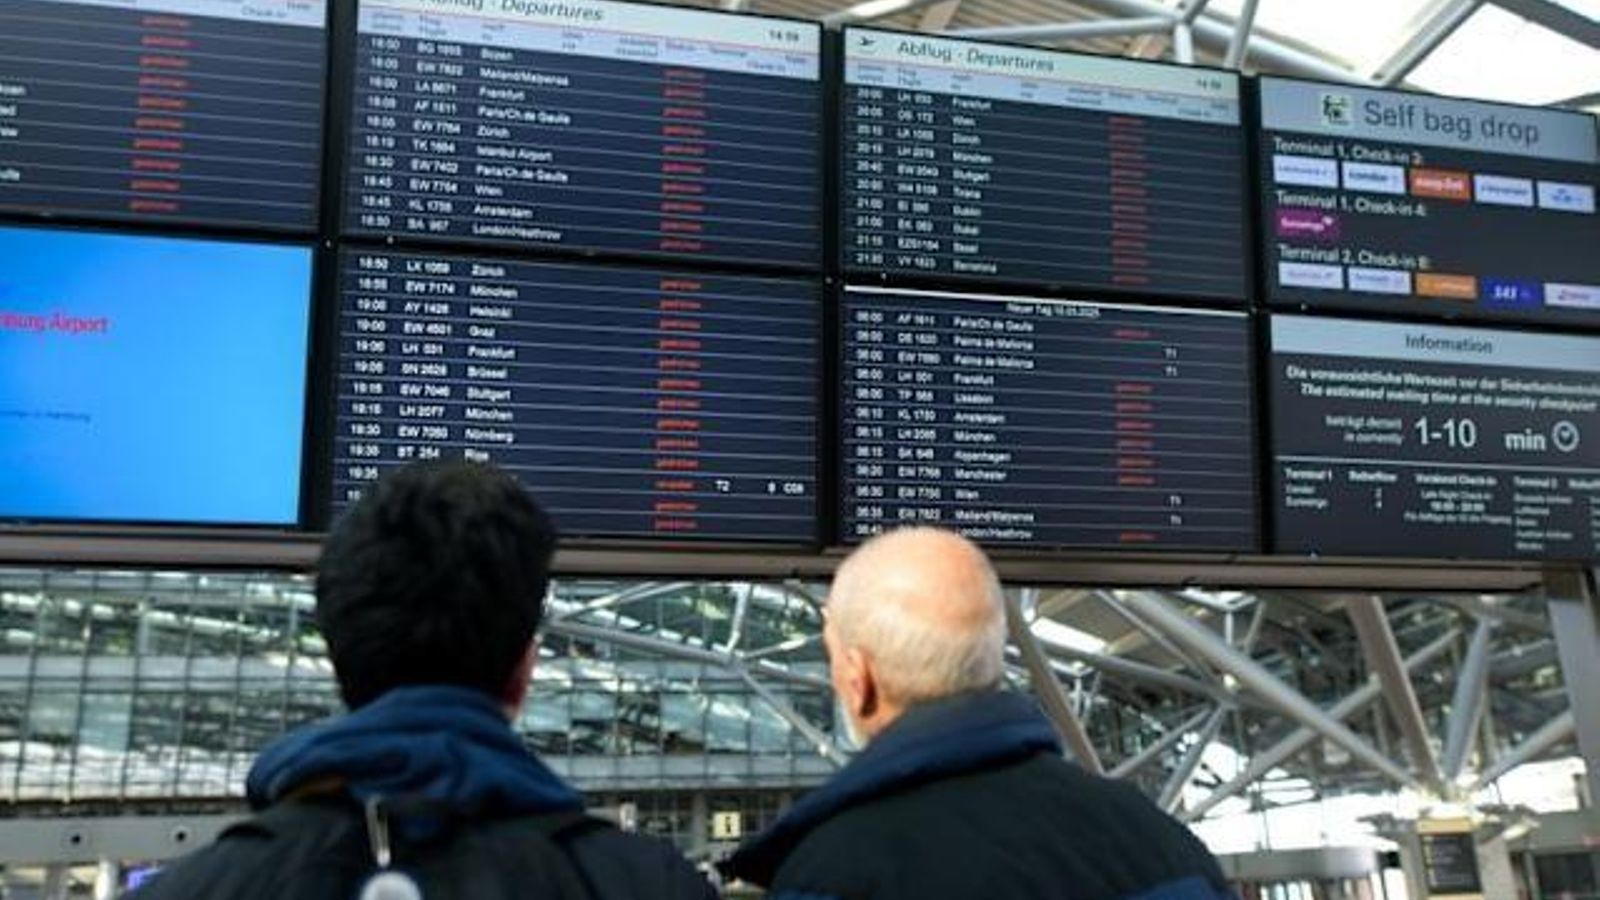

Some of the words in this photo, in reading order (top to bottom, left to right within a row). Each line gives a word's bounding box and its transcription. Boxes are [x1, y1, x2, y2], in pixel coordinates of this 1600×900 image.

[501, 0, 604, 21] Departures
[898, 41, 951, 62] Abflug
[967, 49, 1054, 70] Departures
[1364, 100, 1417, 126] Self
[1424, 108, 1472, 140] bag
[1481, 114, 1540, 146] drop
[1274, 137, 1335, 156] Terminal
[1354, 145, 1407, 162] Check-in
[1276, 191, 1337, 209] Terminal
[1356, 197, 1412, 215] Check-in
[1278, 244, 1339, 261] Terminal
[1358, 250, 1416, 268] Check-in
[1405, 334, 1492, 354] Information
[1286, 365, 1306, 379] Die
[1301, 384, 1323, 396] The
[1326, 386, 1384, 399] estimated
[1431, 392, 1457, 402] time
[1477, 393, 1492, 405] the
[1414, 417, 1477, 448] 1-10
[1505, 430, 1546, 451] min
